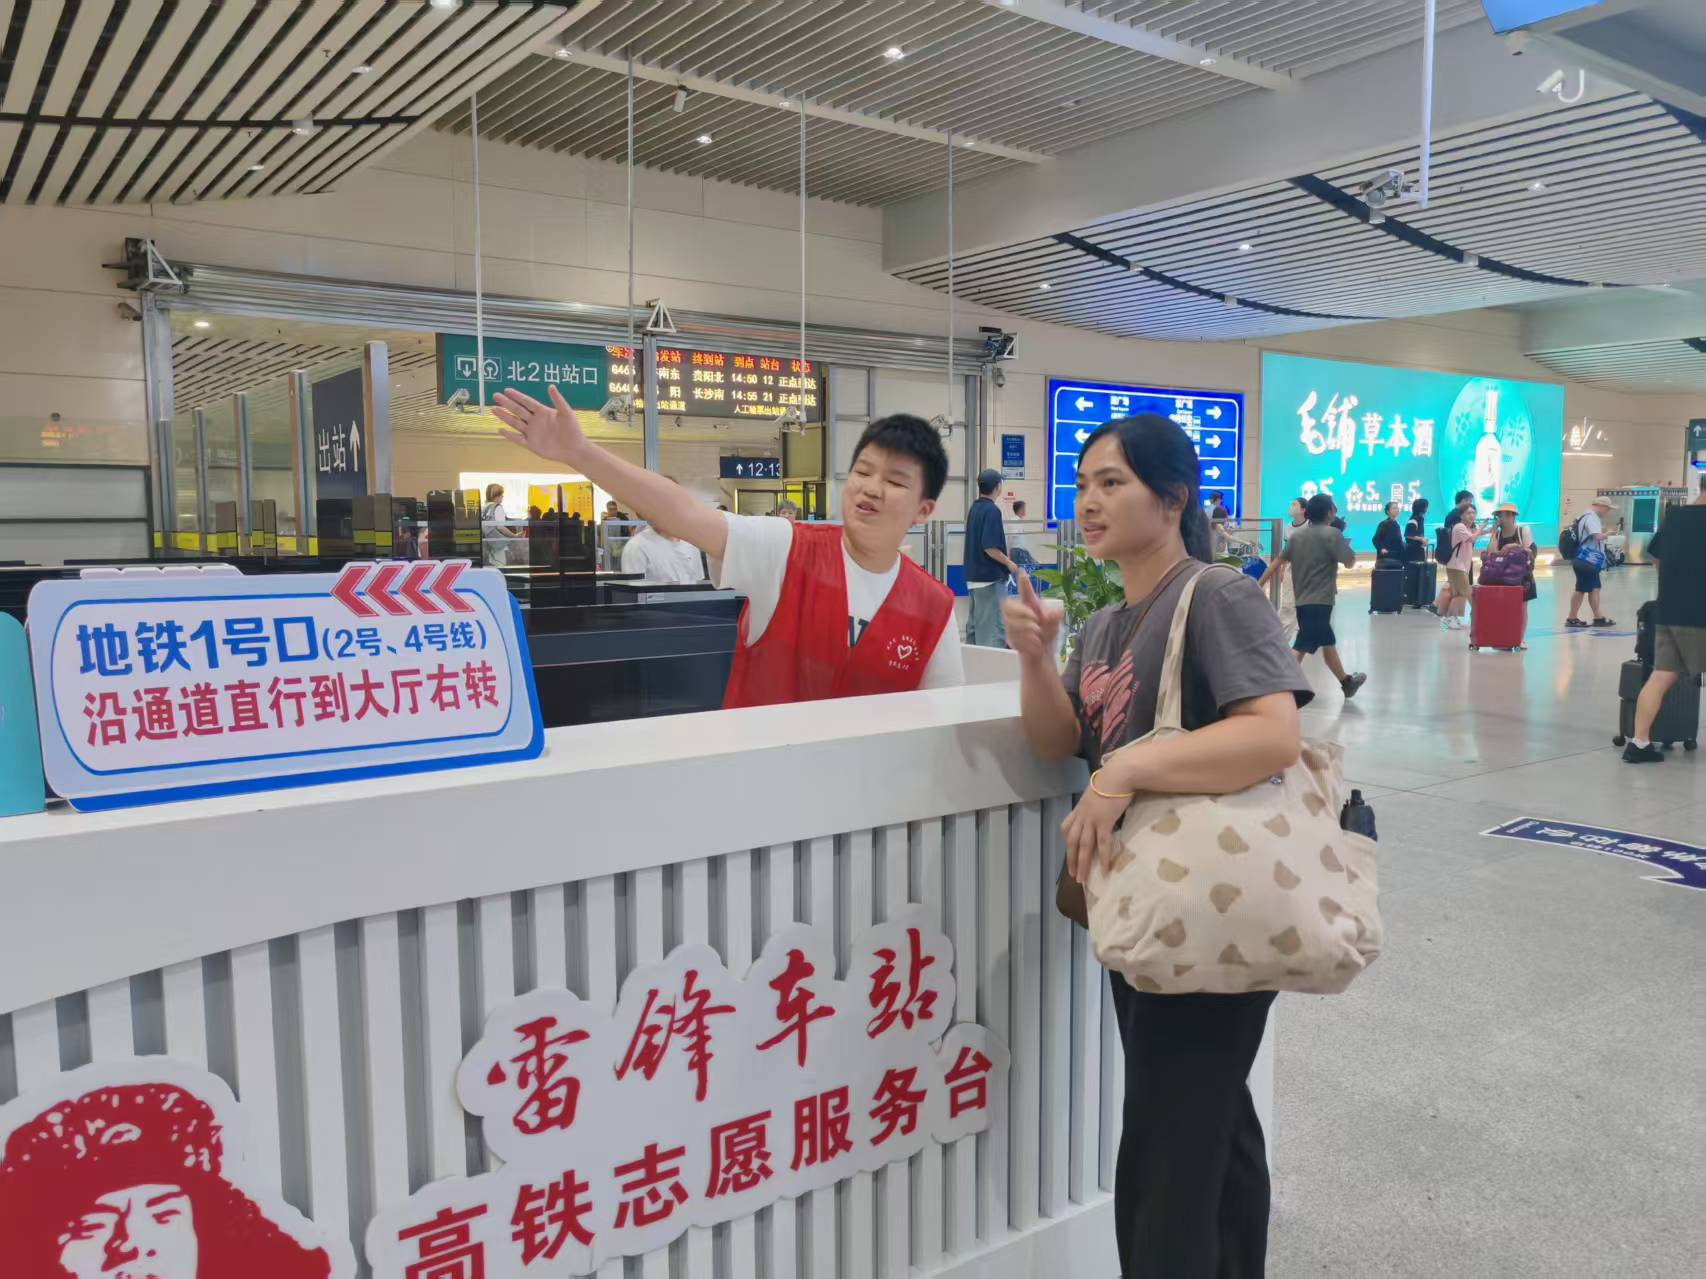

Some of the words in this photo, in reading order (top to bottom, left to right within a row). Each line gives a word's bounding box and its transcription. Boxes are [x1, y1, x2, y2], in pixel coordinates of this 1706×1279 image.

[507, 360, 598, 385] 北2出站口
[692, 352, 725, 369] 终到站
[734, 354, 755, 369] 到点
[760, 357, 780, 372] 站台
[692, 369, 725, 384] 贵阳北
[731, 372, 758, 385] 14:50
[763, 375, 774, 385] 12
[692, 386, 725, 401] 长沙南
[731, 389, 758, 402] 14:55
[763, 392, 773, 402] 21
[319, 423, 346, 474] 出站
[83, 660, 500, 746] 沿通道直行到大厅右转
[487, 928, 938, 1135] 雷锋车站
[399, 1046, 994, 1279] 高铁志愿服务台
